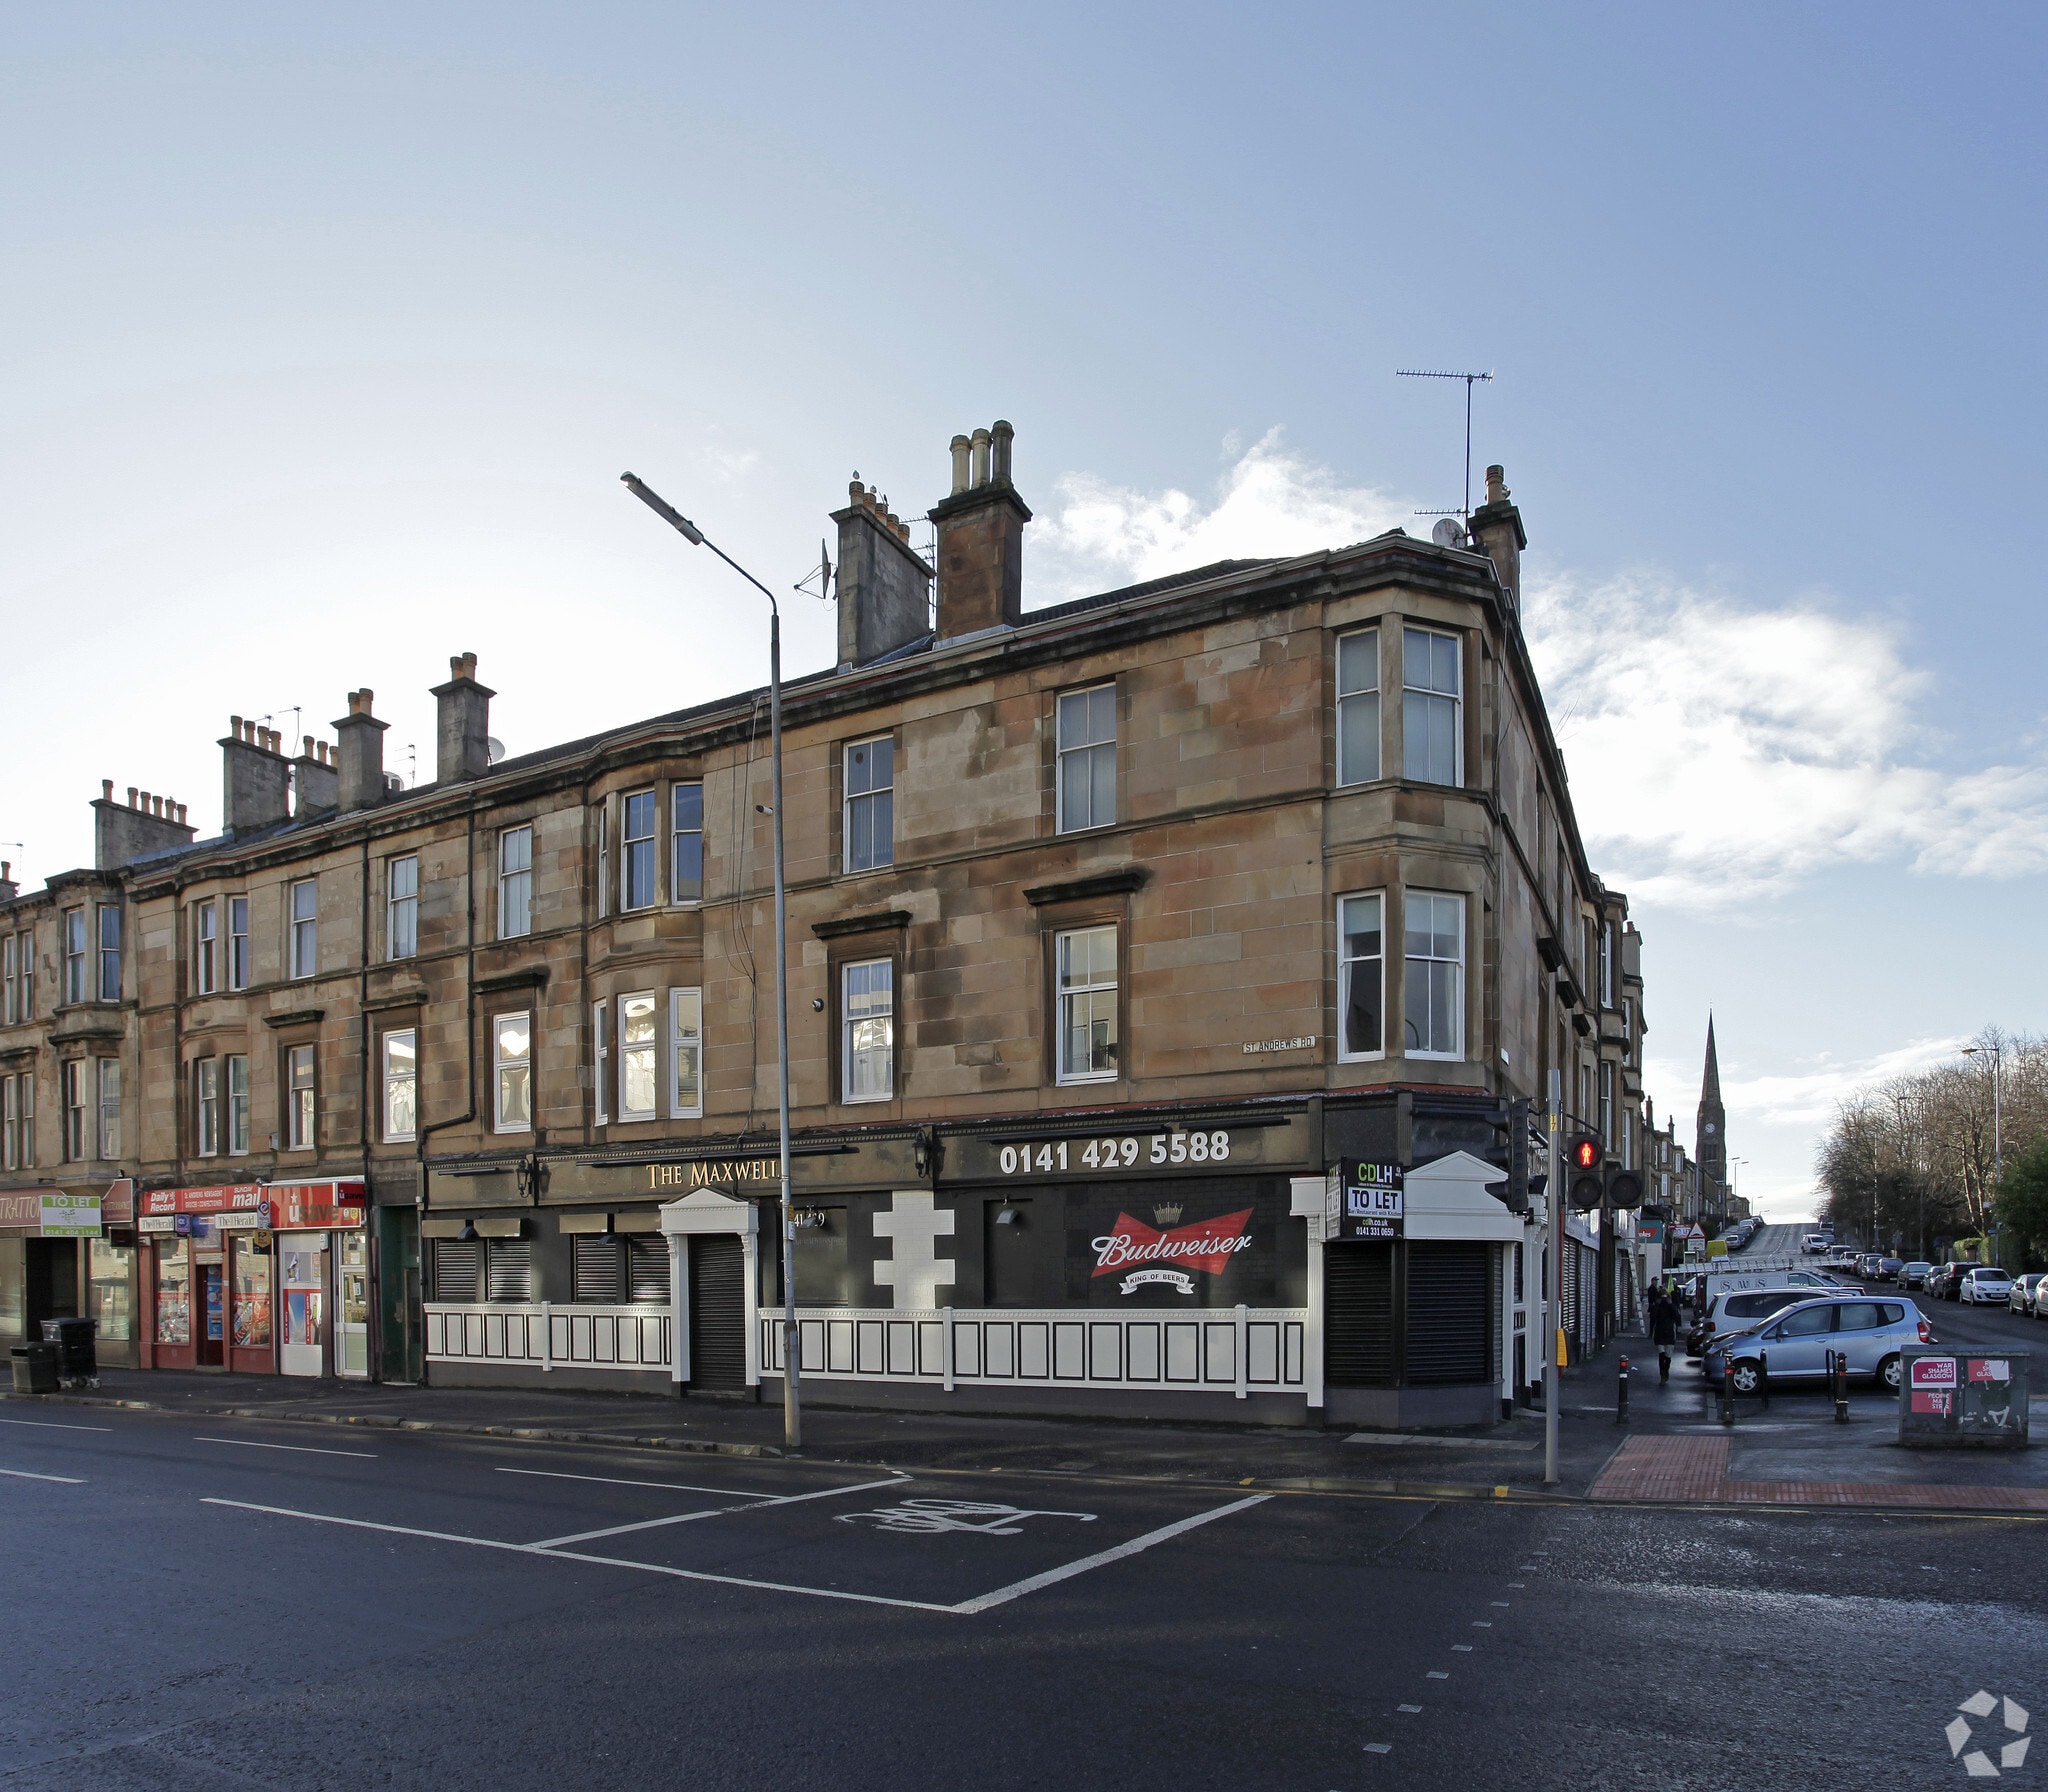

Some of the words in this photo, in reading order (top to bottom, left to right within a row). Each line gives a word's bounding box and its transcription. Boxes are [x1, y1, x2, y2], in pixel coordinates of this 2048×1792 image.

[1258, 1038, 1298, 1051] ANDREWS
[1000, 1141, 1068, 1174] 0141
[1081, 1137, 1139, 1168] 429
[1150, 1130, 1230, 1164] 5588
[645, 1164, 682, 1188] THE
[1358, 1162, 1393, 1183] CDLH
[52, 1197, 68, 1207] TO
[72, 1196, 91, 1207] LET
[150, 1192, 169, 1202] Daily
[232, 1187, 261, 1207] mail
[1352, 1189, 1370, 1208] TO
[1375, 1191, 1398, 1210] LET
[150, 1202, 176, 1211] Record
[289, 1203, 340, 1223] usave
[142, 1218, 153, 1230] The
[154, 1218, 174, 1230] Herald
[219, 1214, 230, 1226] The
[233, 1214, 255, 1227] Herald
[1355, 1226, 1370, 1236] 0141
[1370, 1227, 1380, 1236] 331
[1091, 1230, 1253, 1267] Budweiser
[1129, 1273, 1147, 1284] KING
[1162, 1273, 1185, 1283] BEERS
